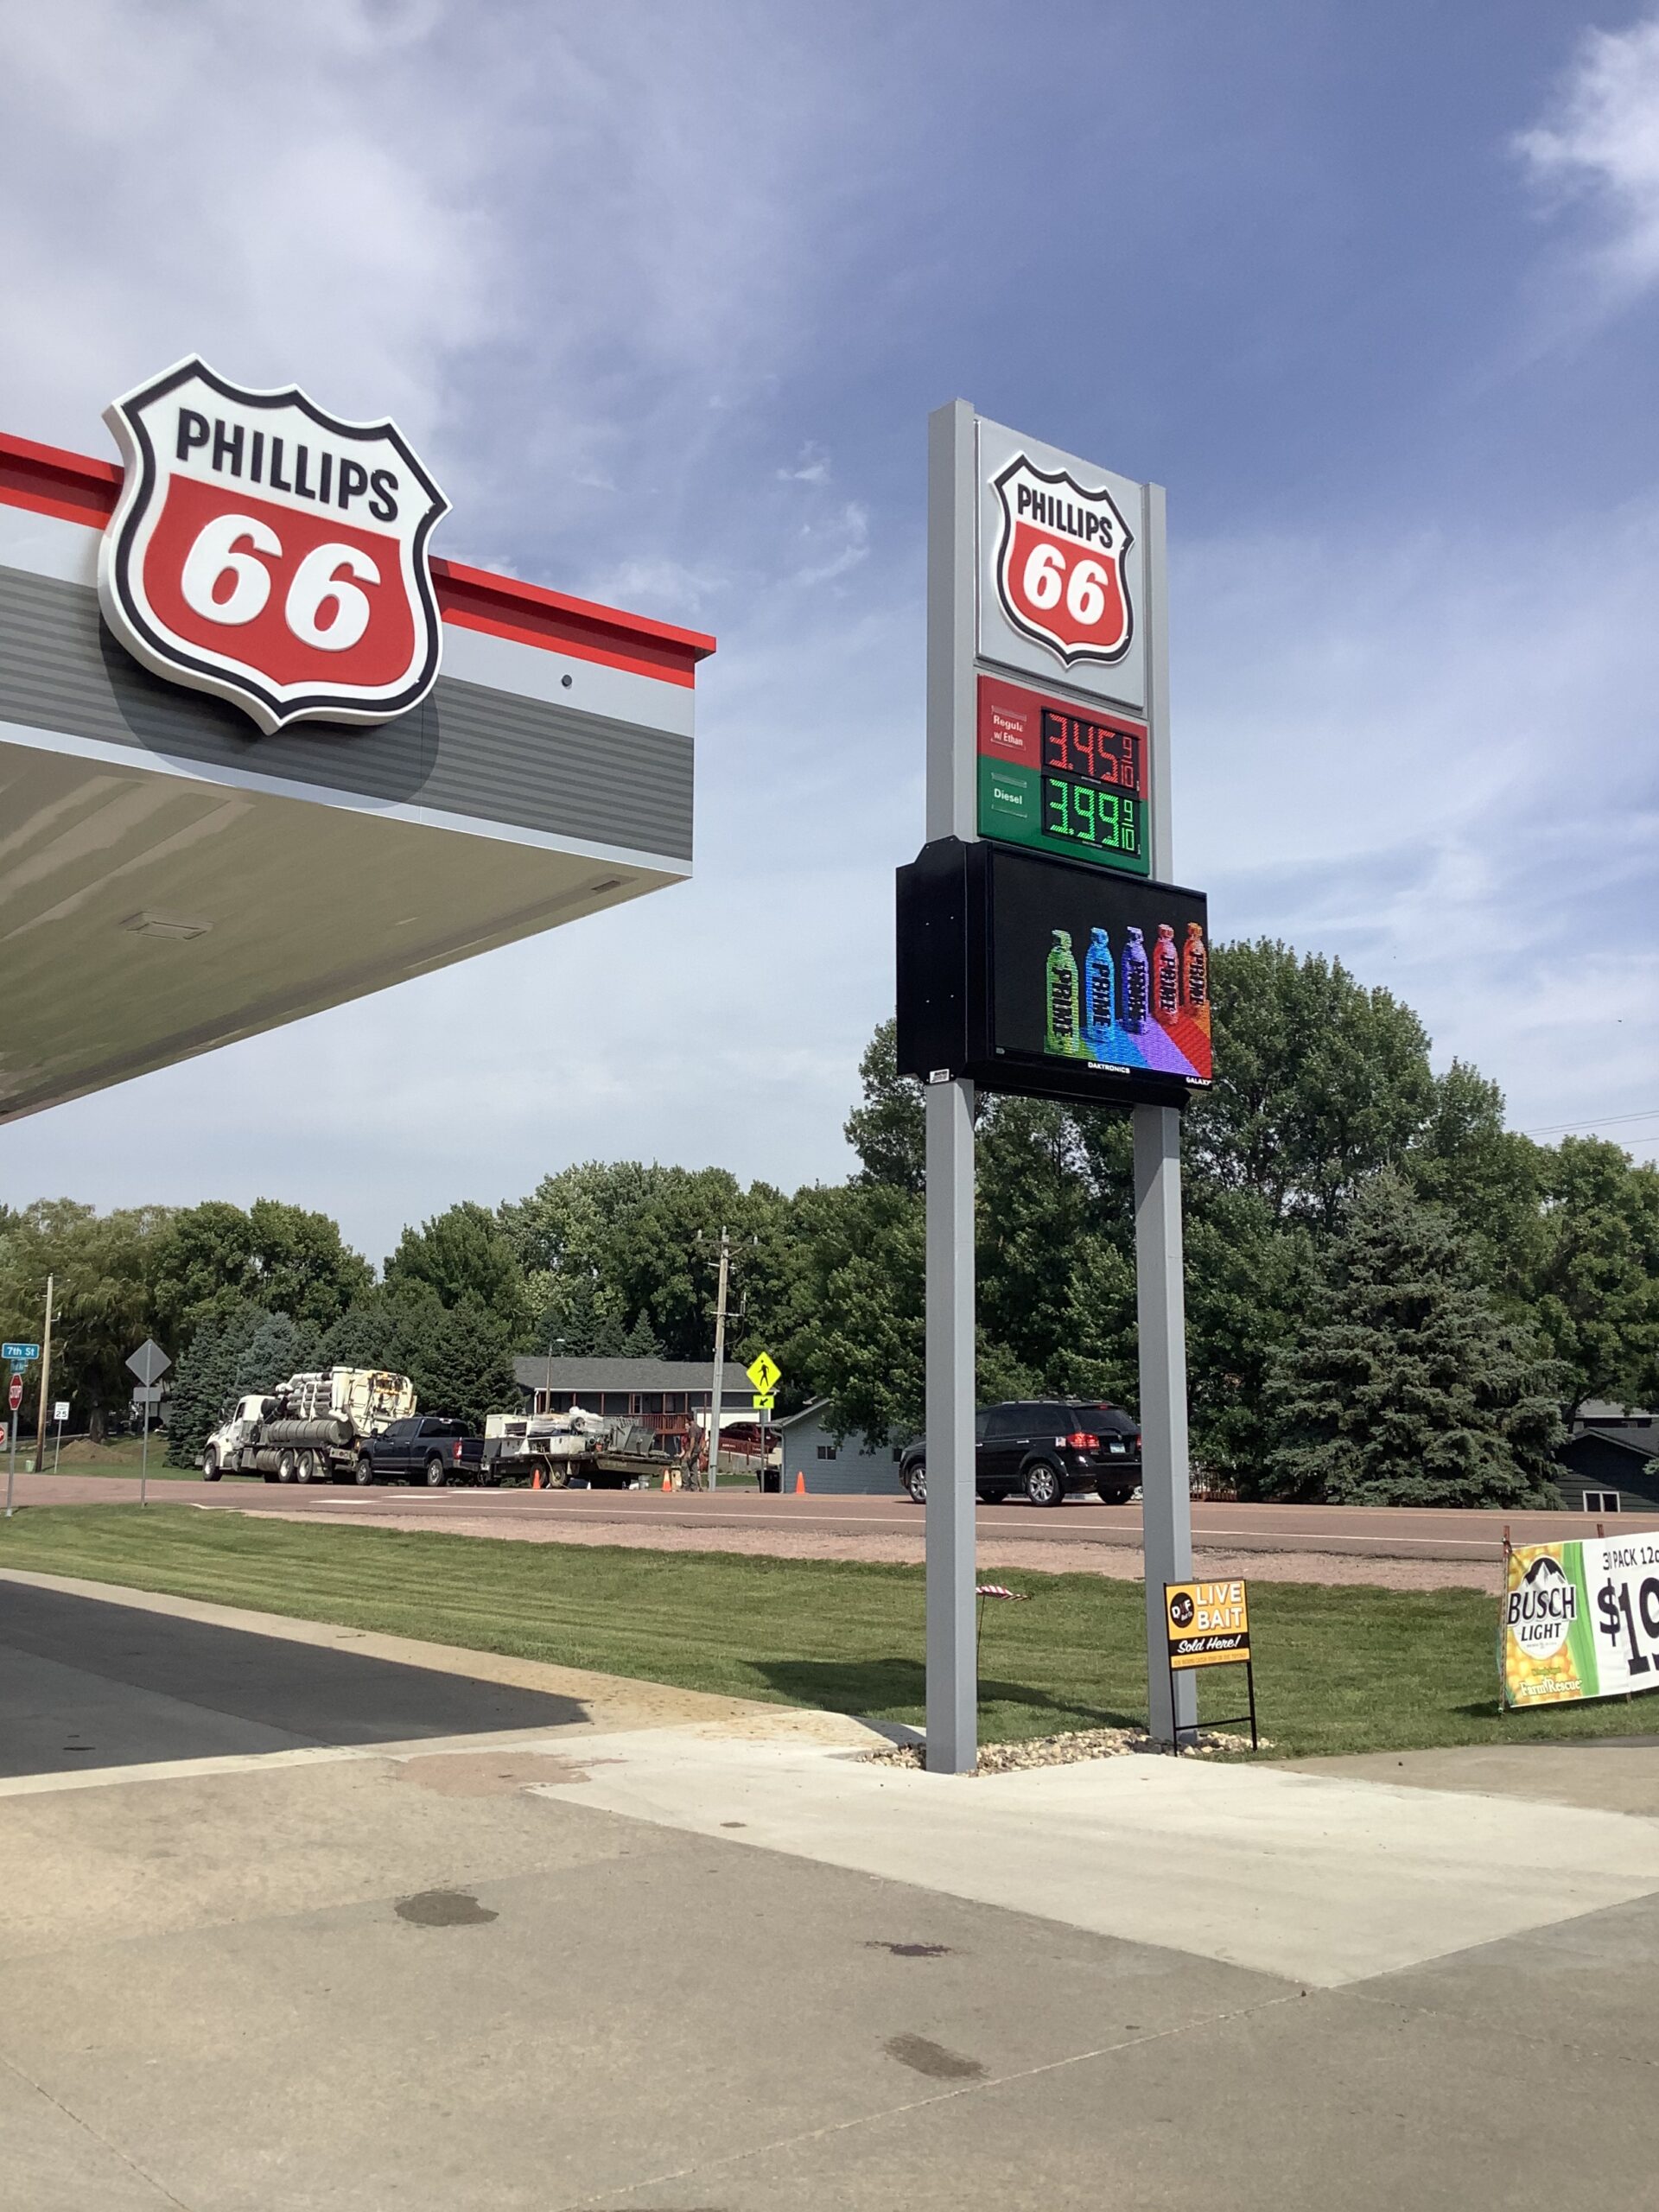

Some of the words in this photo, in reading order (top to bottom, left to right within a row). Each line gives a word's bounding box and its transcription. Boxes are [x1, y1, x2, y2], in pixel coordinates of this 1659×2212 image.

[175, 407, 399, 523] PHILLIPS
[1017, 483, 1113, 549] PHILLIPS
[181, 514, 381, 652] 66
[1023, 543, 1109, 626] 66
[1003, 732, 1023, 747] Ethan
[994, 787, 1022, 804] Diesel
[1049, 779, 1120, 848] 3.99
[1091, 962, 1111, 1027] PRIME
[1088, 1062, 1130, 1074] DAKTRONICS
[7, 1347, 22, 1356] 7th
[25, 1347, 35, 1357] St
[1612, 1548, 1638, 1568] PACK
[1196, 1583, 1242, 1605] LIVE
[1507, 1586, 1576, 1624] BUSCH
[1197, 1607, 1243, 1630] BAIT
[1521, 1623, 1562, 1642] LIGHT
[1177, 1637, 1205, 1654] Sold
[1206, 1635, 1242, 1649] Here!
